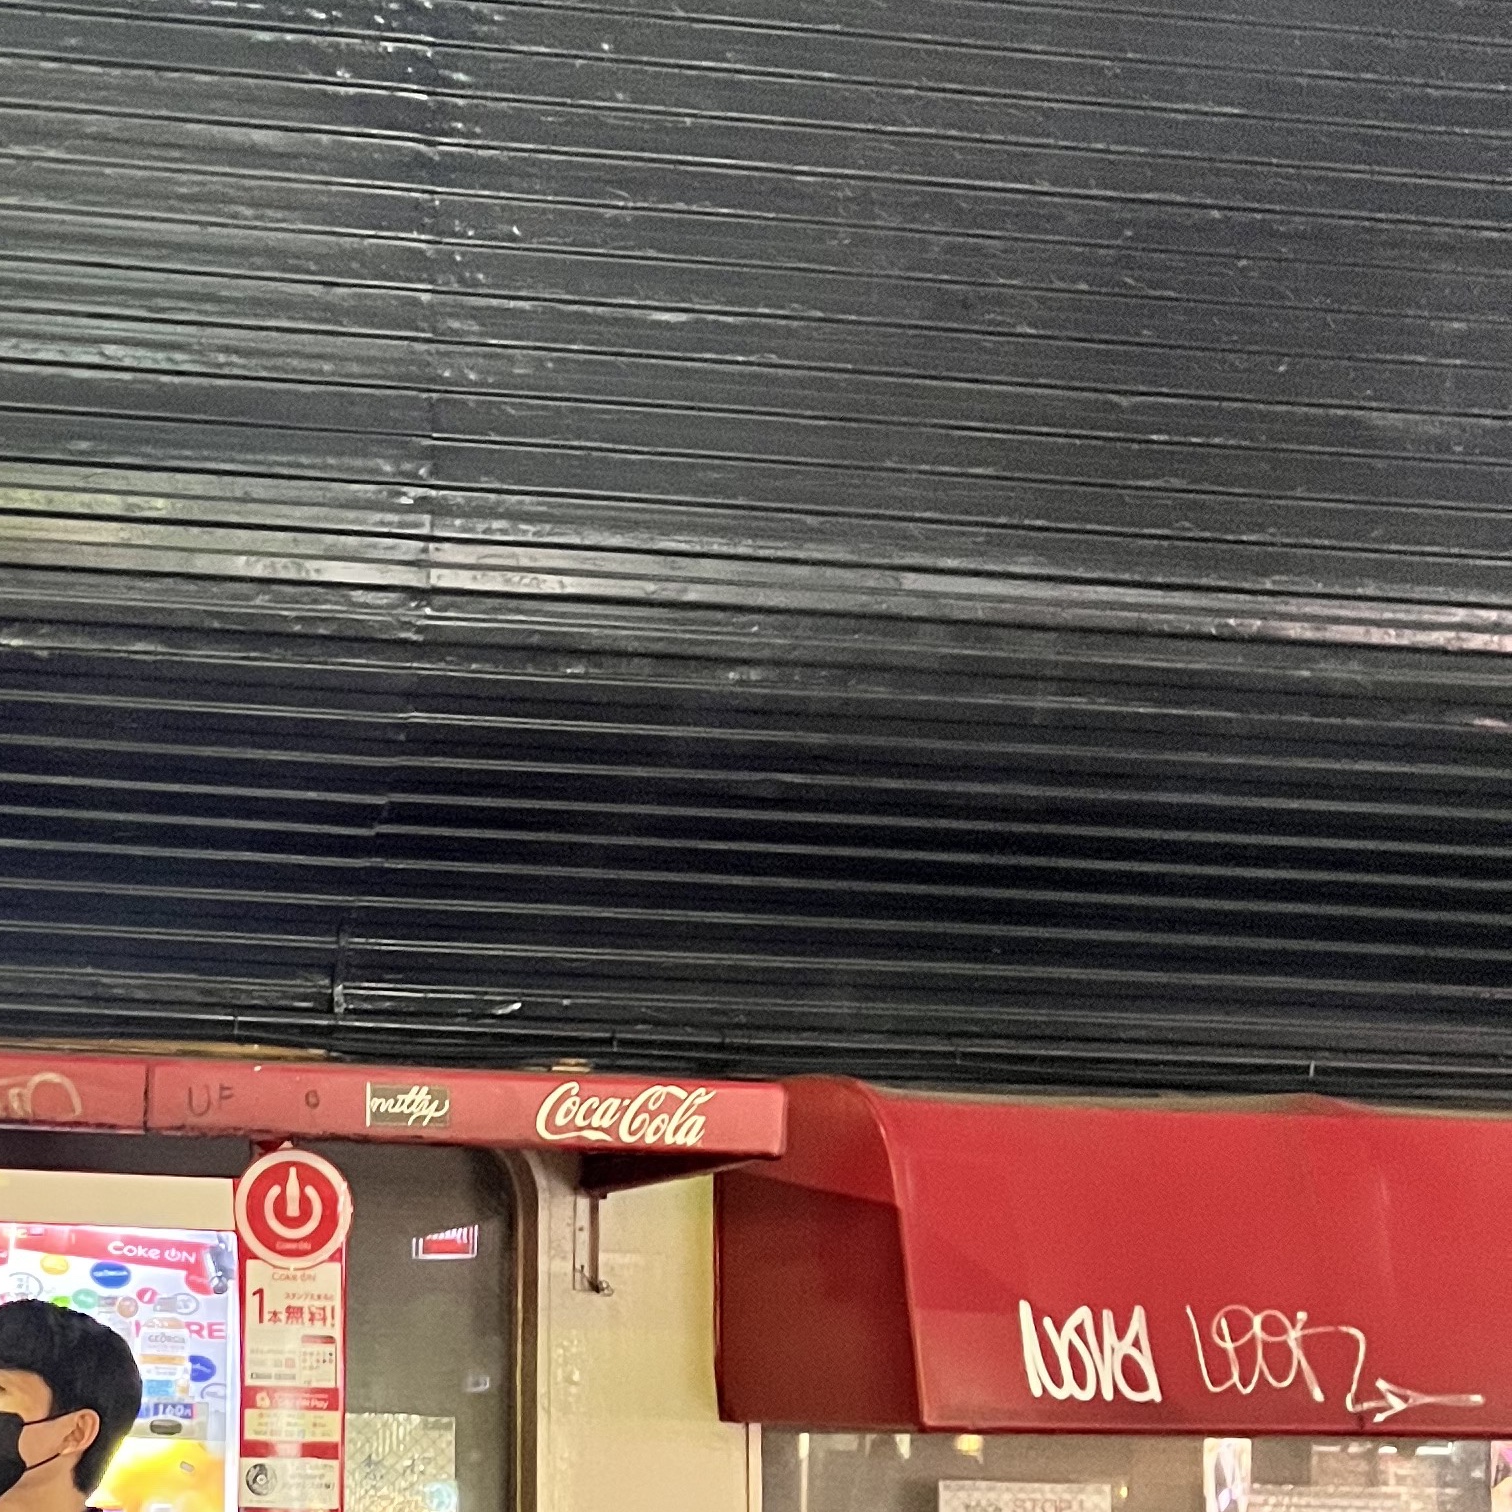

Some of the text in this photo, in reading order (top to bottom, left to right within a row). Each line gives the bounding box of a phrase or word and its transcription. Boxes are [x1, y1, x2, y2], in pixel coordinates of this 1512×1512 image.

[535, 1080, 717, 1146] Coca-Cola
[107, 1240, 197, 1264] Coke ON
